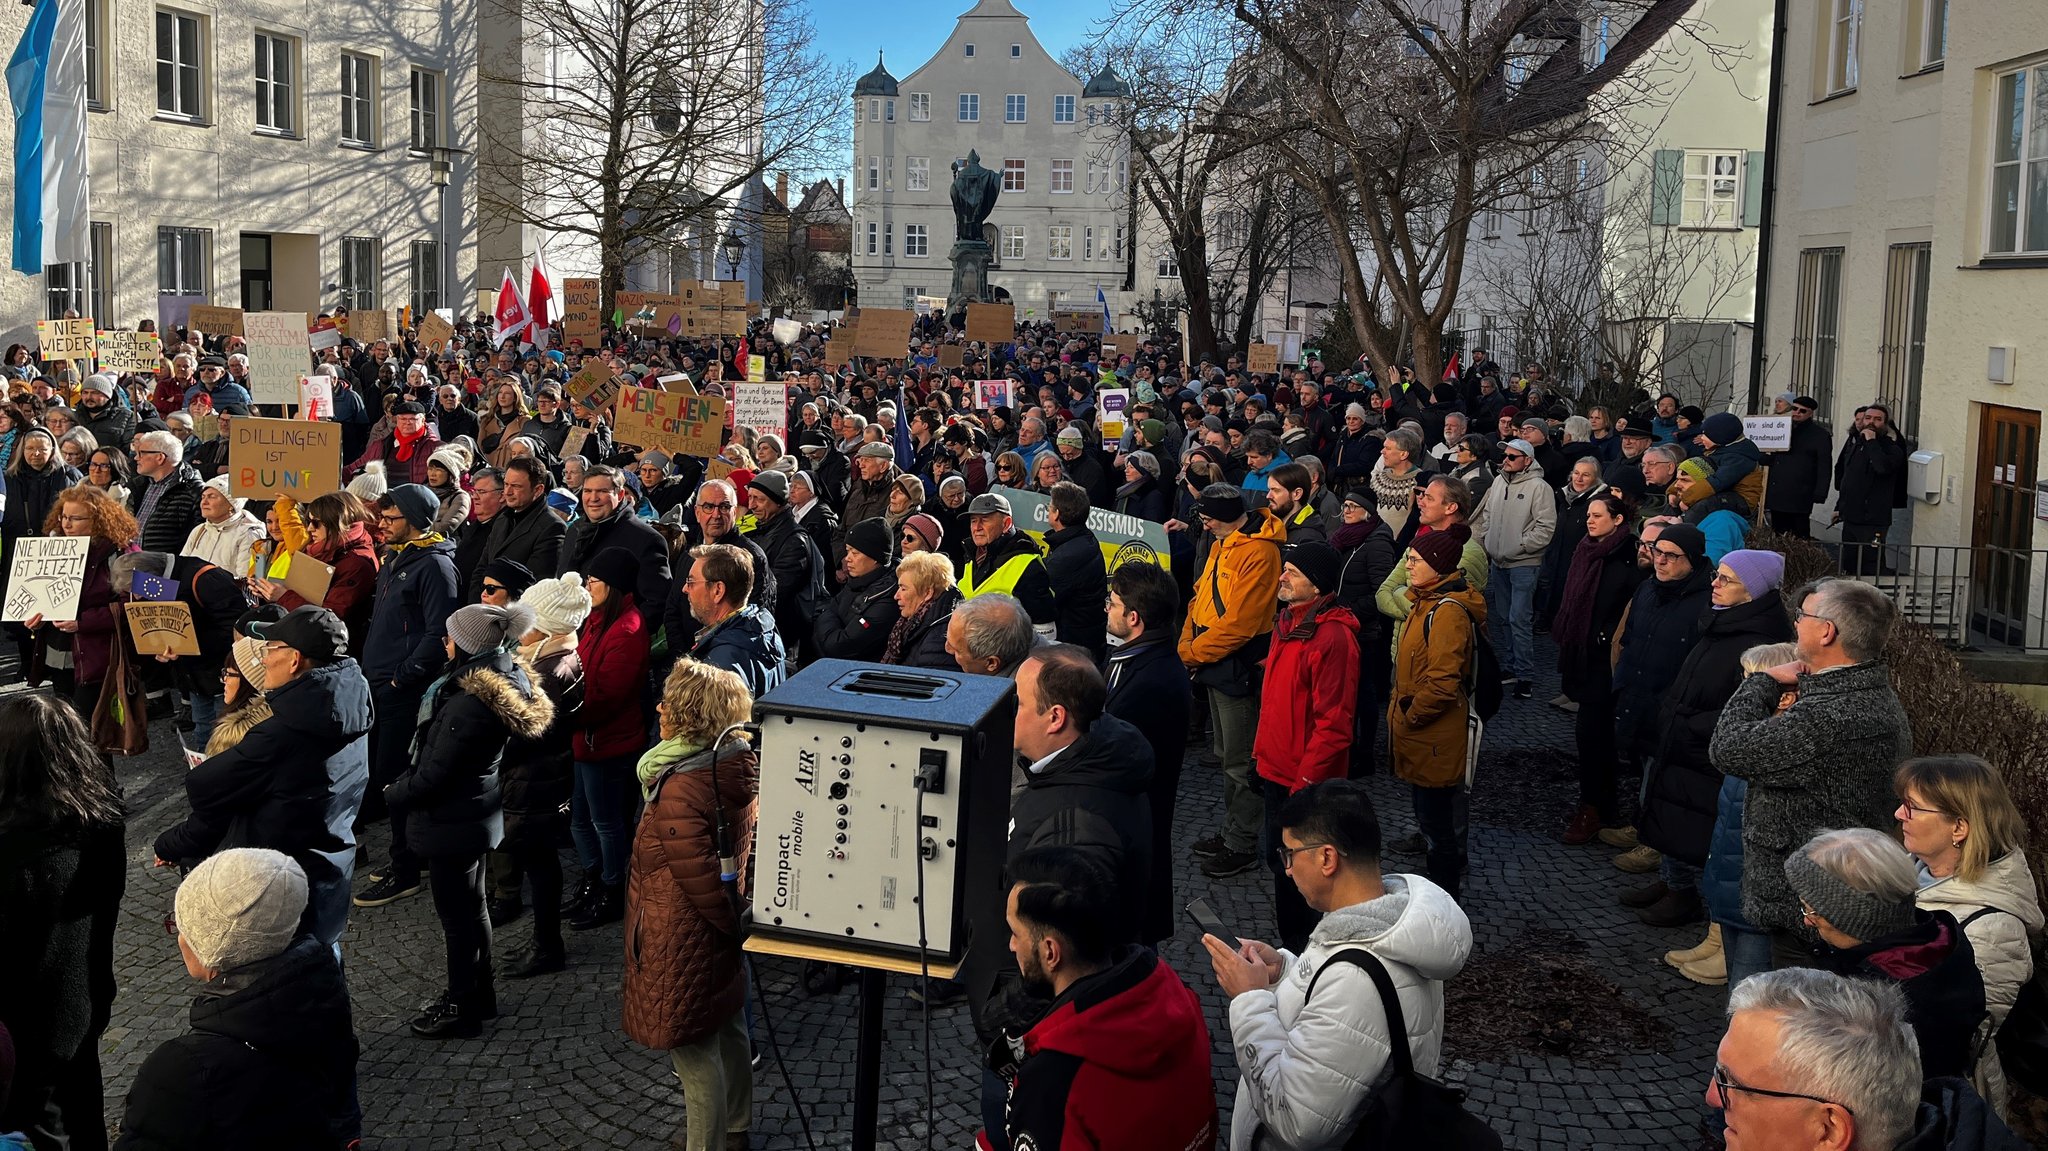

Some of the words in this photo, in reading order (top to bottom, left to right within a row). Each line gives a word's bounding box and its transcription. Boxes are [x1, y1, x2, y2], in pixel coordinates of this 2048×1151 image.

[616, 294, 645, 306] NAZIS
[54, 321, 80, 335] NIE
[246, 316, 284, 329] GEGEN
[41, 337, 93, 352] WIEDER
[113, 332, 137, 342] KEIN
[247, 328, 308, 346] RASSISMUS
[99, 340, 151, 352] MILLIMETER
[114, 350, 137, 358] NACH
[250, 345, 273, 360] FÜR
[279, 348, 308, 360] MEHR
[105, 356, 155, 369] RECHTS!!!
[623, 388, 719, 424] MENSCHEN-
[240, 428, 328, 451] DILLINGEN
[640, 432, 678, 449] RECHTE
[679, 436, 719, 454] MENSCHEN
[266, 451, 288, 462] IST
[241, 467, 312, 489] BUNT
[15, 539, 37, 558] NIE
[39, 539, 78, 557] WIEDER
[1121, 546, 1149, 563] ZUSAMMEN
[14, 560, 33, 577] IST
[35, 553, 85, 576] JETZT!
[142, 606, 158, 617] EINE
[159, 605, 191, 622] ZUKUNFT
[140, 617, 158, 630] OHNE
[795, 750, 815, 795] AER
[792, 810, 804, 857] mobile
[773, 833, 792, 908] Compact
